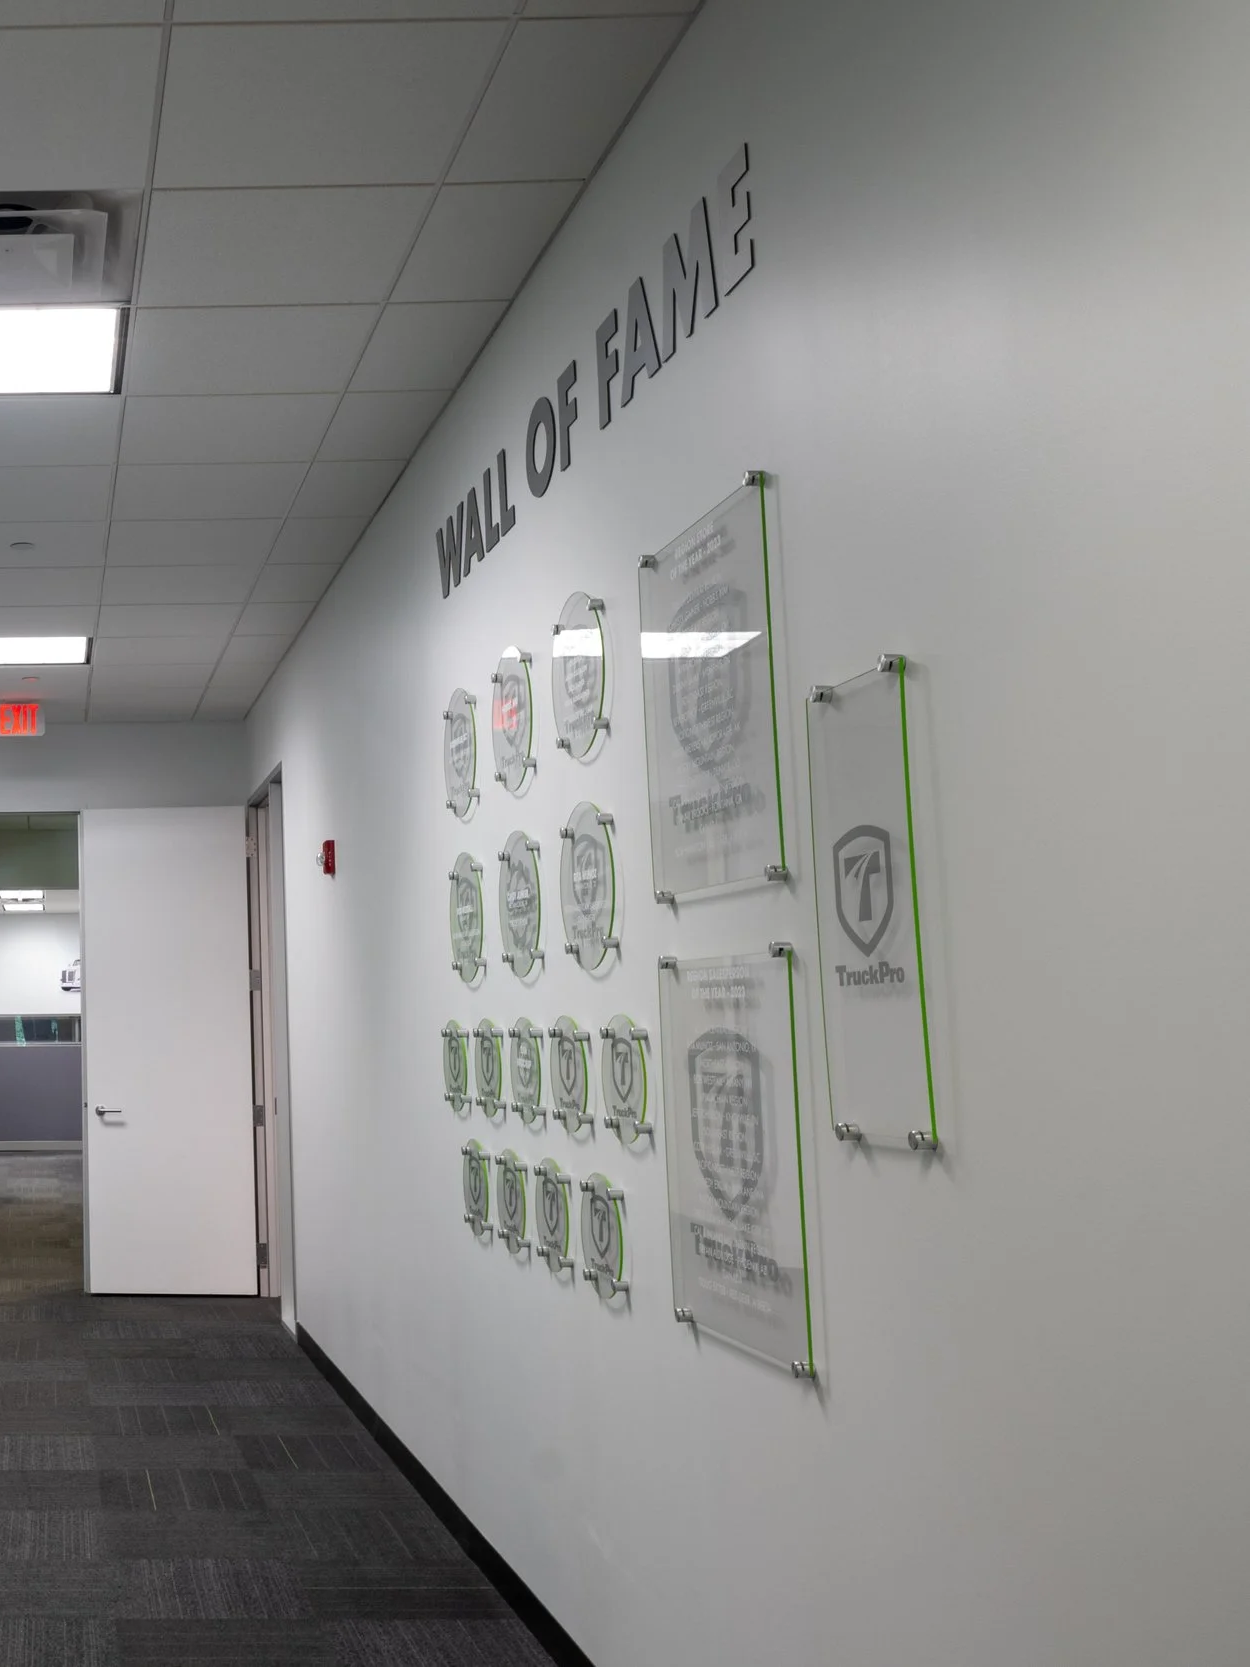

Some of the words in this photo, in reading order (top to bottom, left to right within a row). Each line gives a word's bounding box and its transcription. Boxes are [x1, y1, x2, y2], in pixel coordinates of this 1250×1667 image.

[435, 448, 516, 599] WALL
[525, 359, 578, 499] OF
[595, 142, 756, 431] FAME
[835, 961, 905, 987] TruckPro
